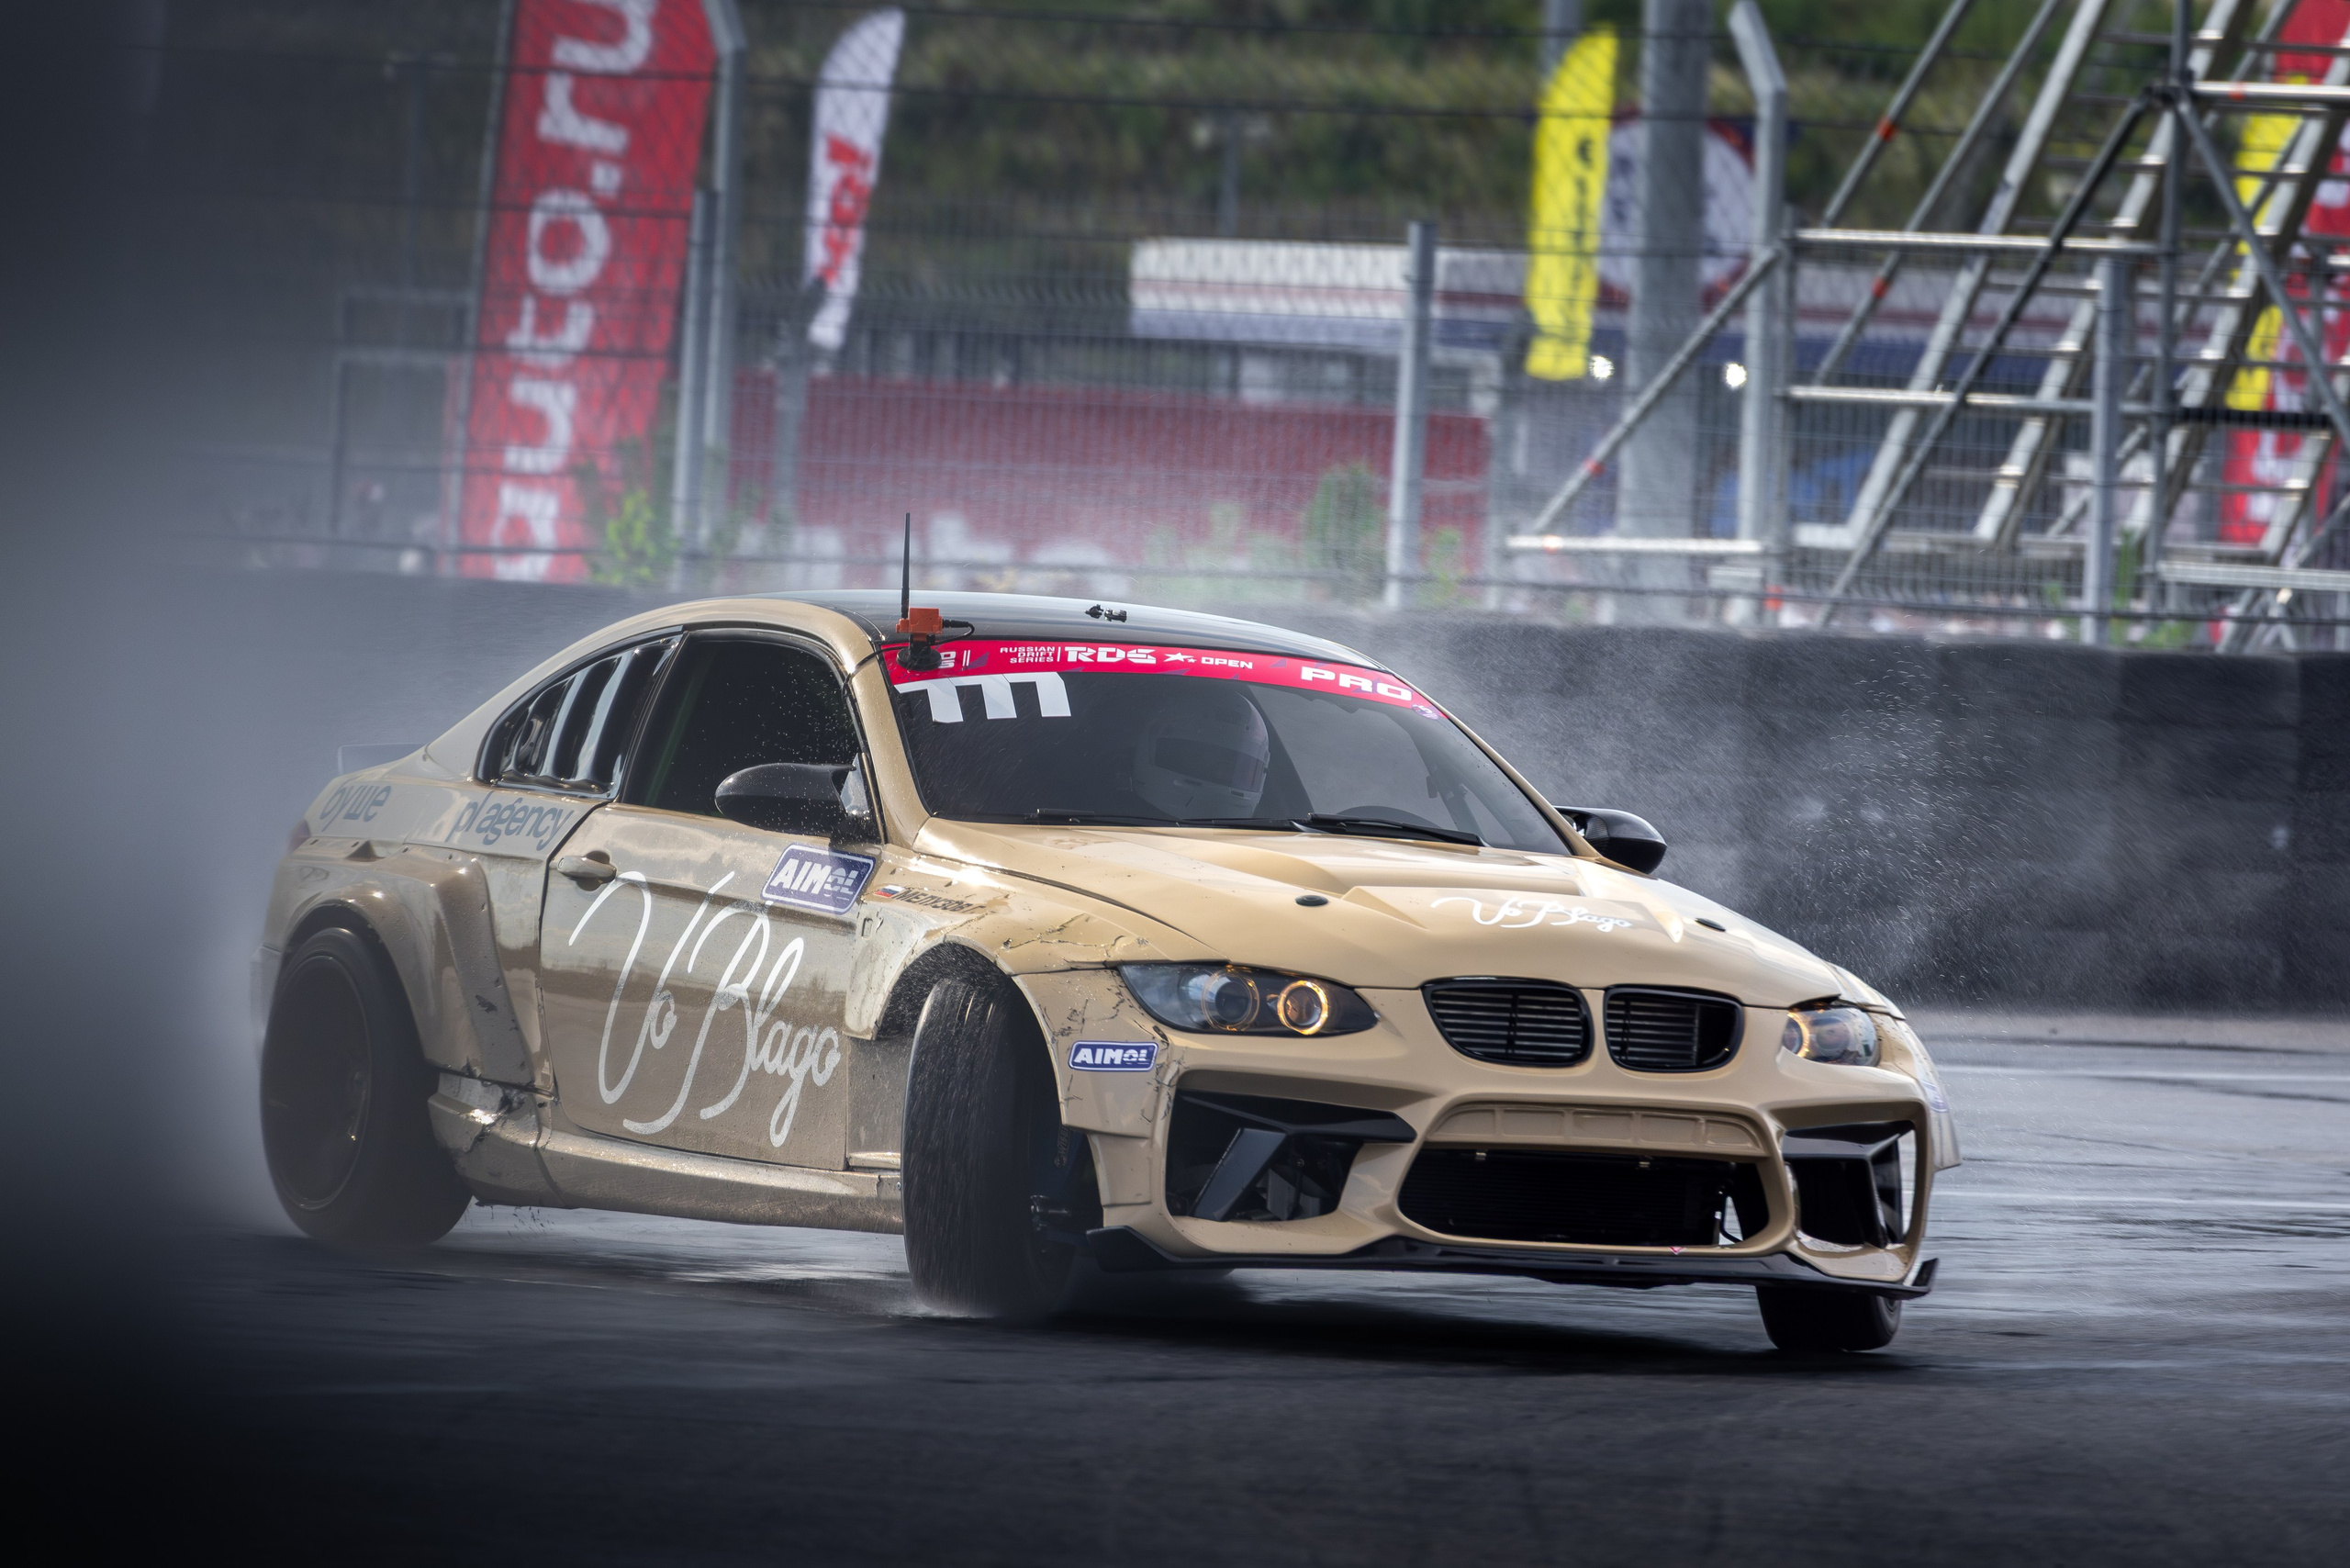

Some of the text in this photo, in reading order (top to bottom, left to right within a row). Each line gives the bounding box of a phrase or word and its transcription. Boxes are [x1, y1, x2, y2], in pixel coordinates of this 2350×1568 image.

[1064, 646, 1254, 669] RDS OPEN
[1300, 666, 1413, 701] PRO
[770, 857, 859, 900] AIMOL
[1073, 1047, 1150, 1065] AIMOL
